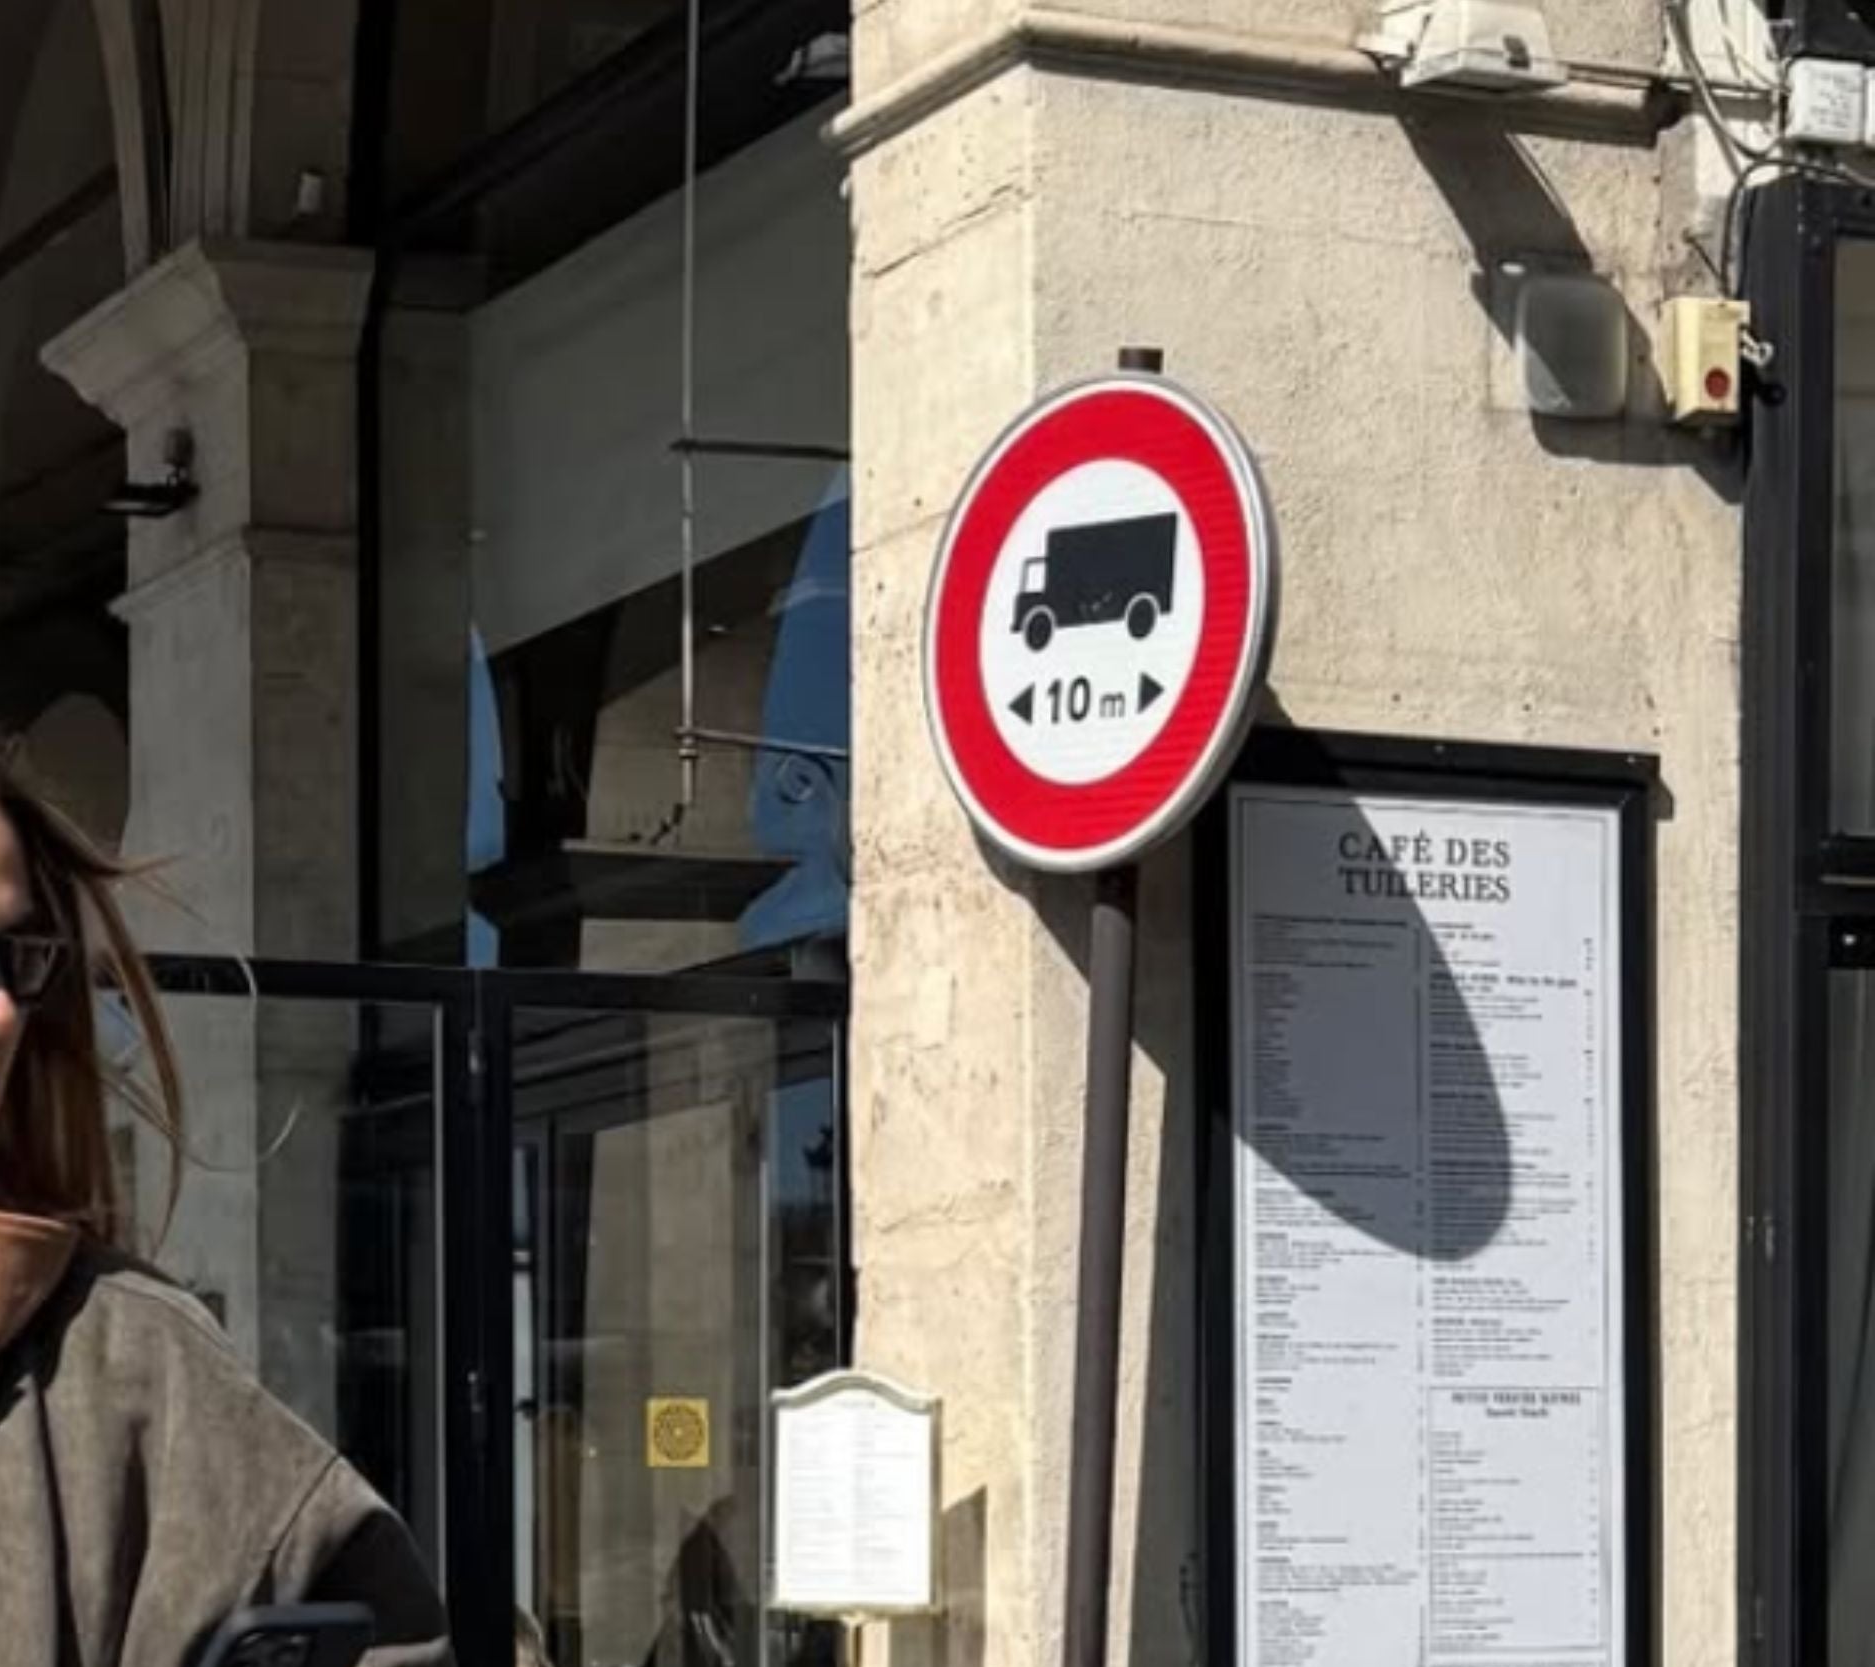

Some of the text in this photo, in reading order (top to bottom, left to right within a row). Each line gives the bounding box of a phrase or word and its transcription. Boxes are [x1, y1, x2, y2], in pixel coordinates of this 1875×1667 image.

[1047, 676, 1126, 723] 10 m
[1338, 827, 1511, 868] CAFÉ DES
[1337, 865, 1511, 902] TUILERIES
